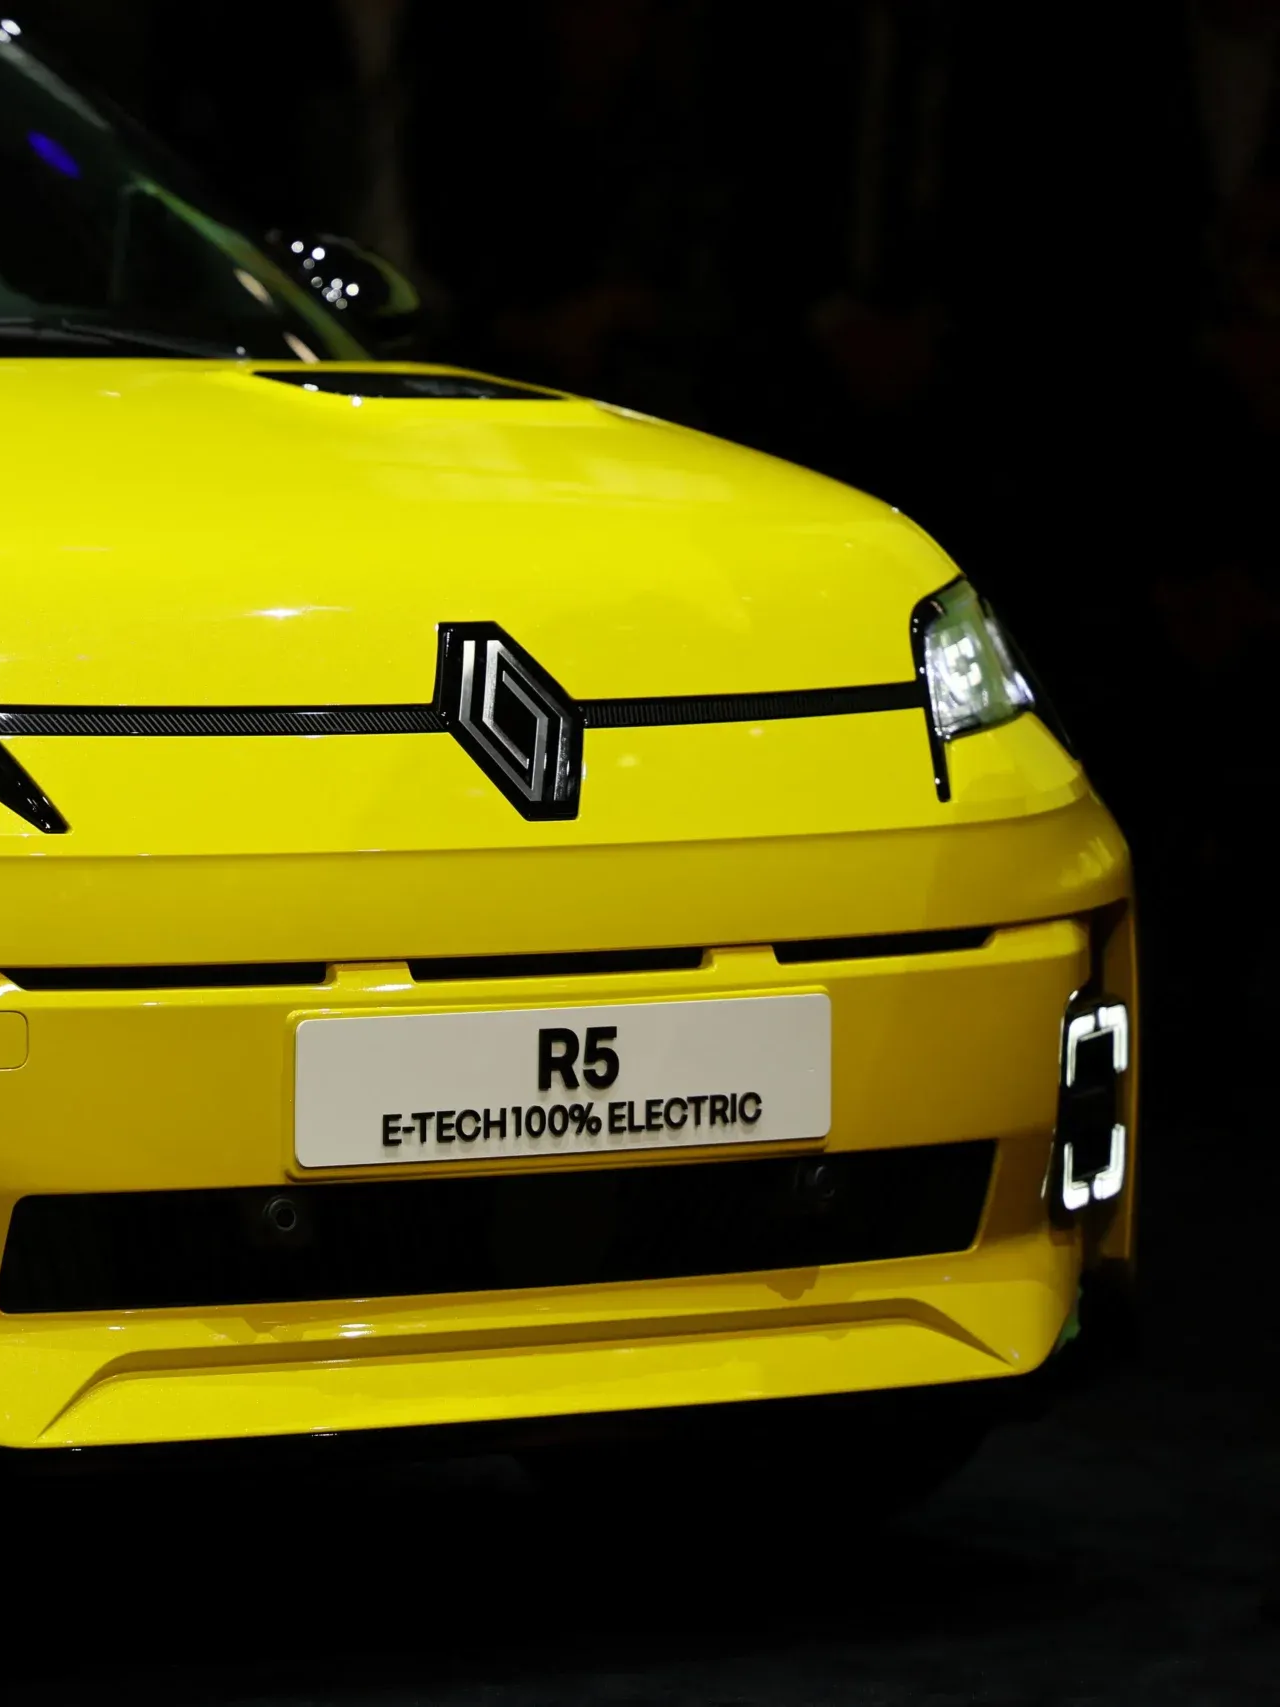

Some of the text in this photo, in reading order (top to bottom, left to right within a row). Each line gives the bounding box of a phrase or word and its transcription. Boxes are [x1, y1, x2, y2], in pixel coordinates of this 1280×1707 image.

[537, 1025, 620, 1092] R5
[381, 1092, 762, 1148] E-TECH 100% ELECTRIC
